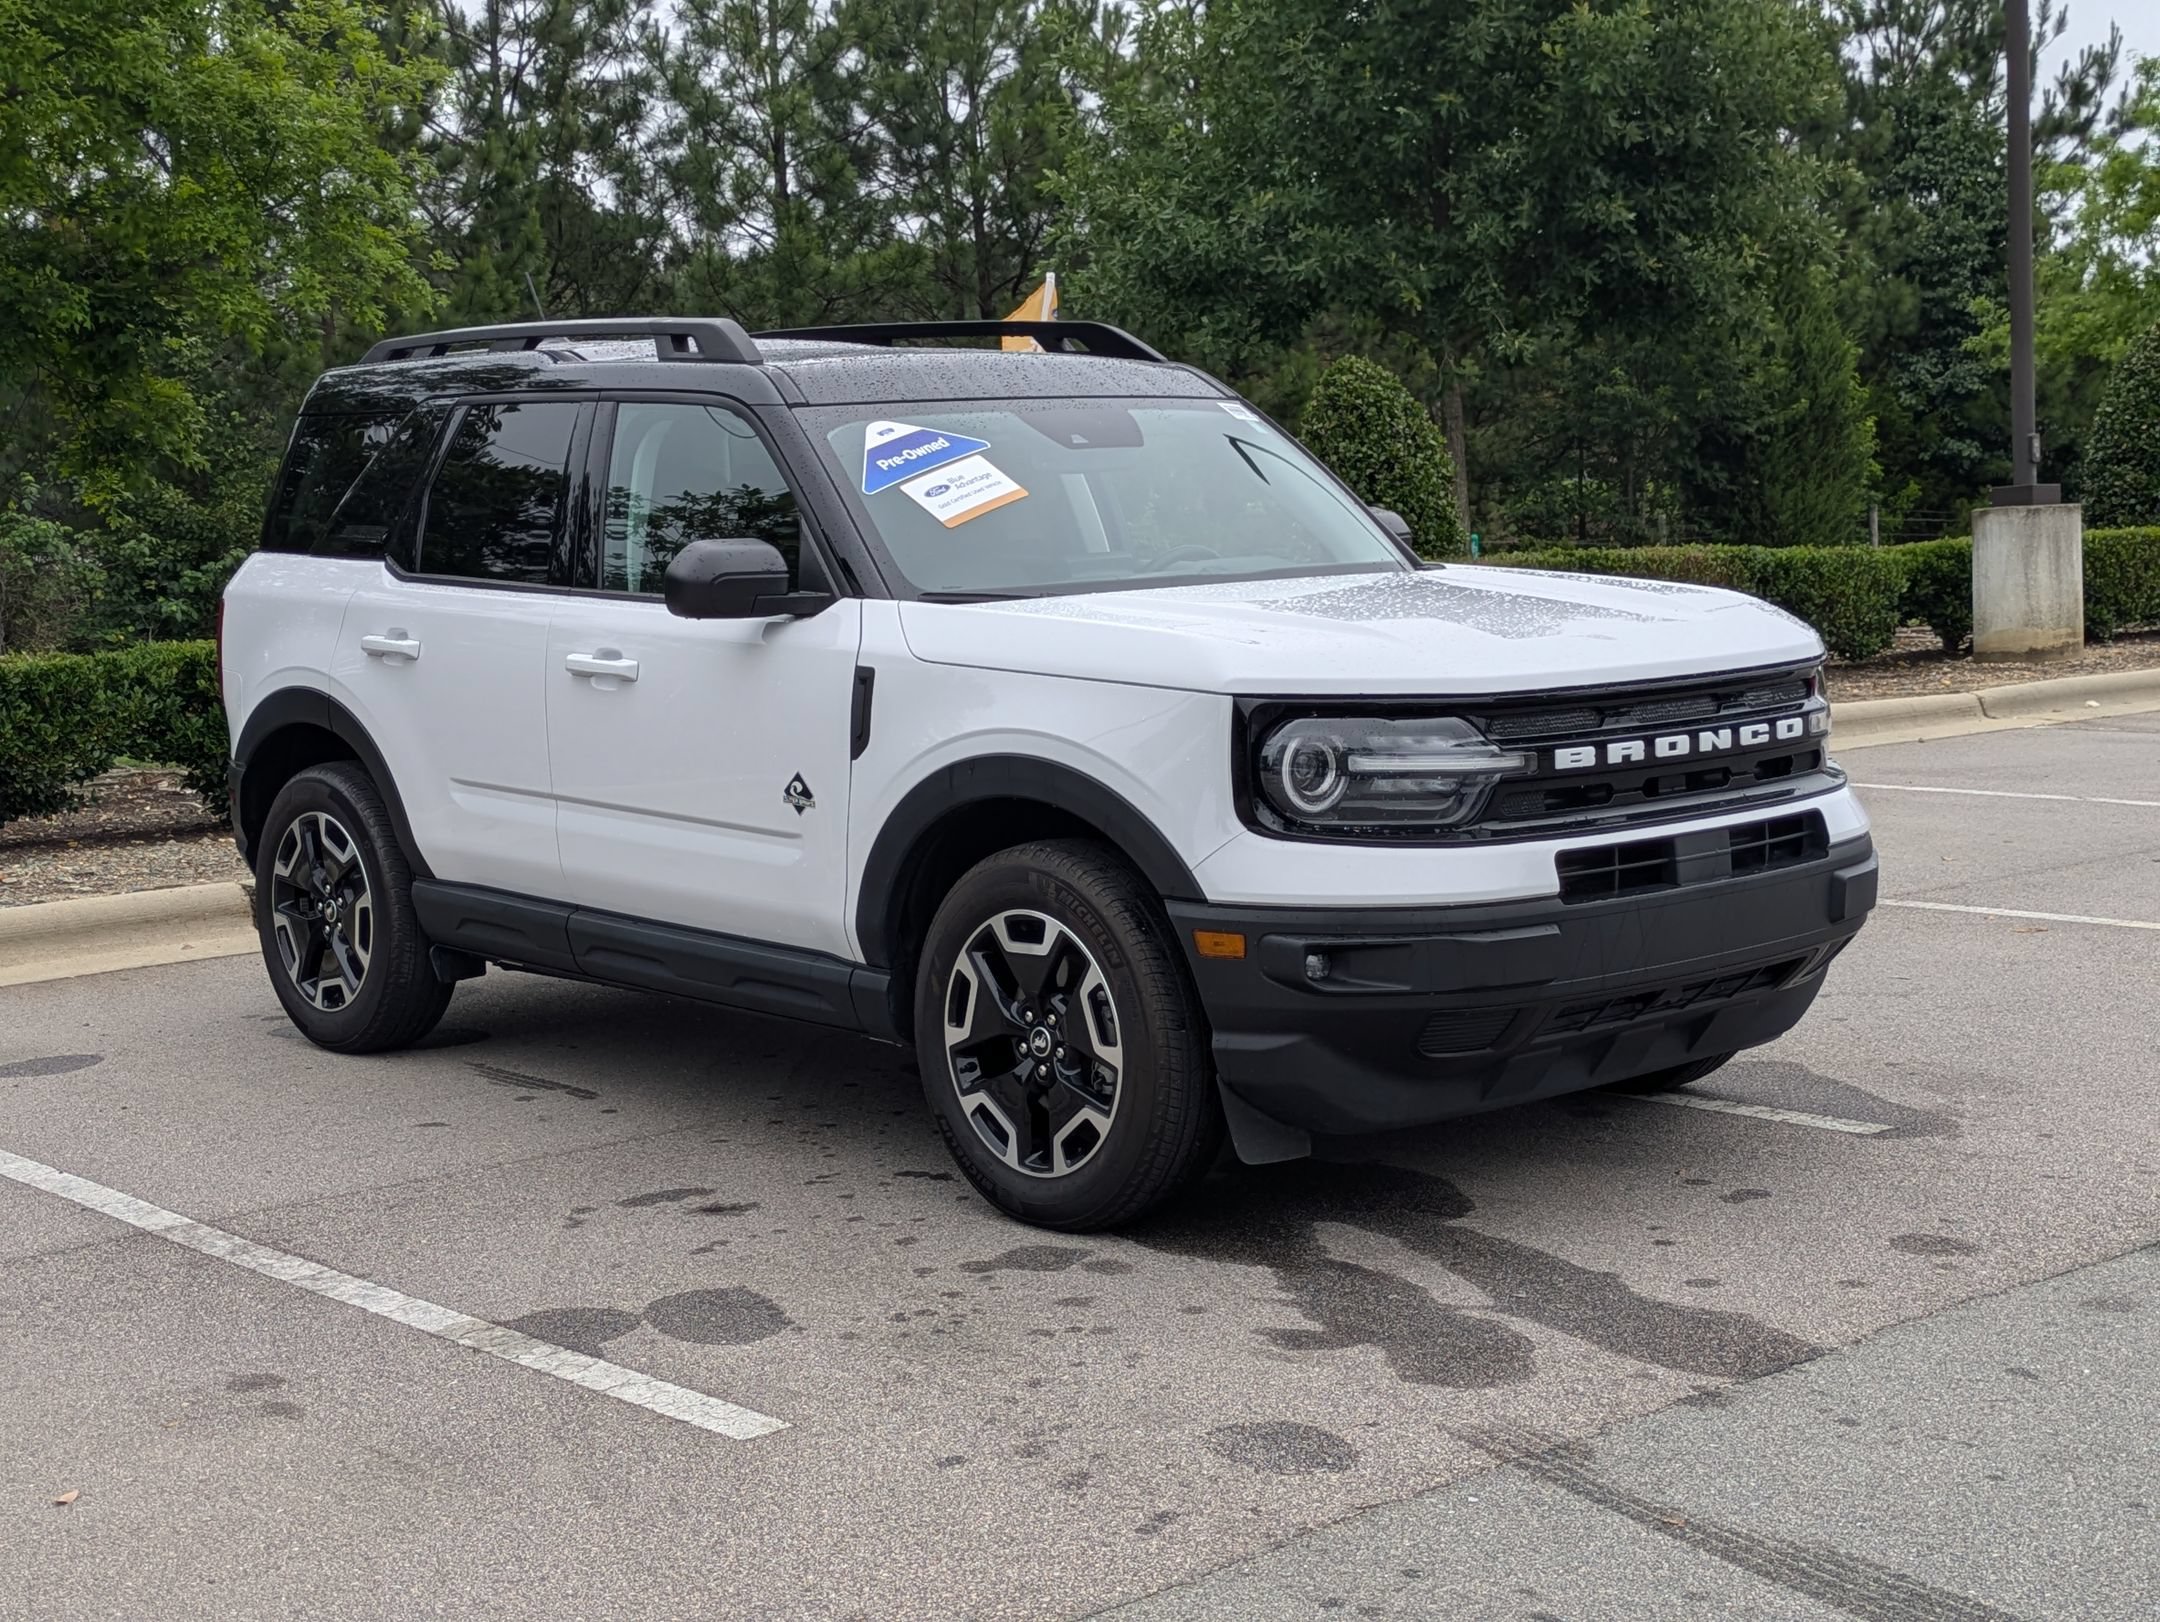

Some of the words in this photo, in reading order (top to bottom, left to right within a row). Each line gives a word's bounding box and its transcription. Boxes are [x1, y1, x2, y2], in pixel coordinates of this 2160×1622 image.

[876, 437, 950, 471] Pre-Owned
[927, 485, 949, 497] Ford
[1554, 717, 1803, 770] BRONCO
[1057, 888, 1122, 967] MICHELIN
[940, 1120, 994, 1191] MICHELIN
